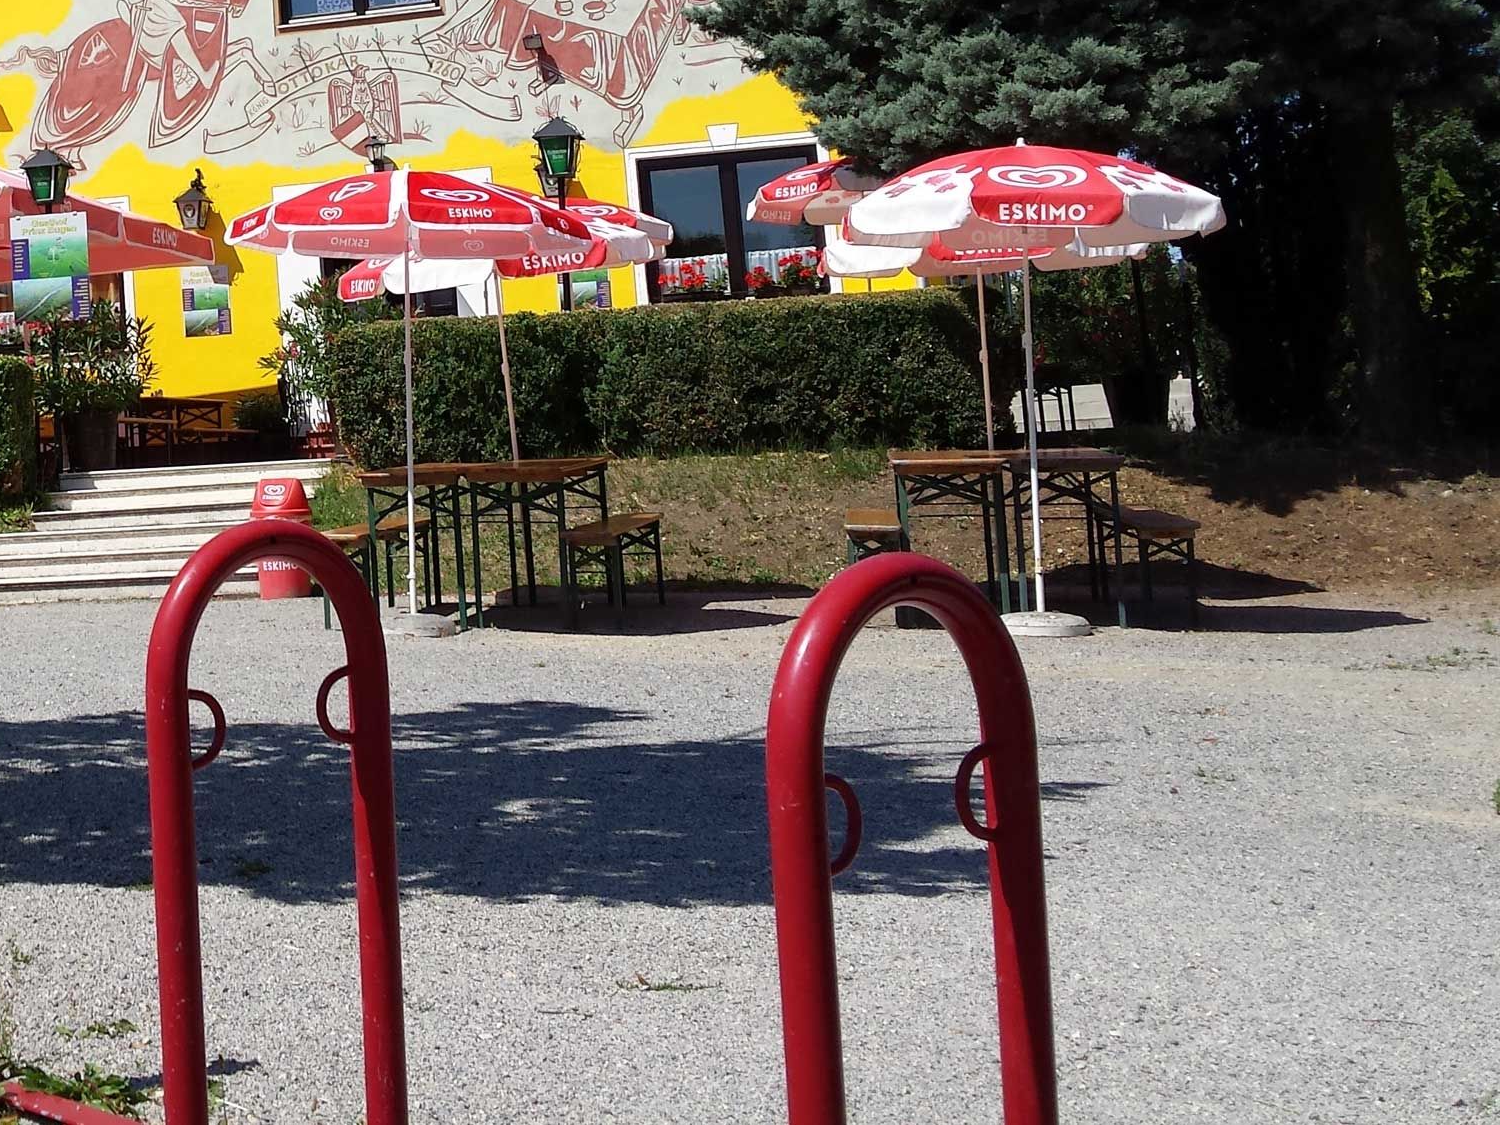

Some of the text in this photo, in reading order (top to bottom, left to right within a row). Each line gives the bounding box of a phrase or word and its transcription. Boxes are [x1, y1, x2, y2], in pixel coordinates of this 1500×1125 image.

[277, 55, 359, 95] OTTOKAR
[775, 182, 818, 198] ESKIMO
[448, 208, 493, 218] ESKIMO
[999, 203, 1086, 221] ESKIMO
[152, 226, 178, 247] ESKIMO
[522, 251, 585, 270] ESKIMO
